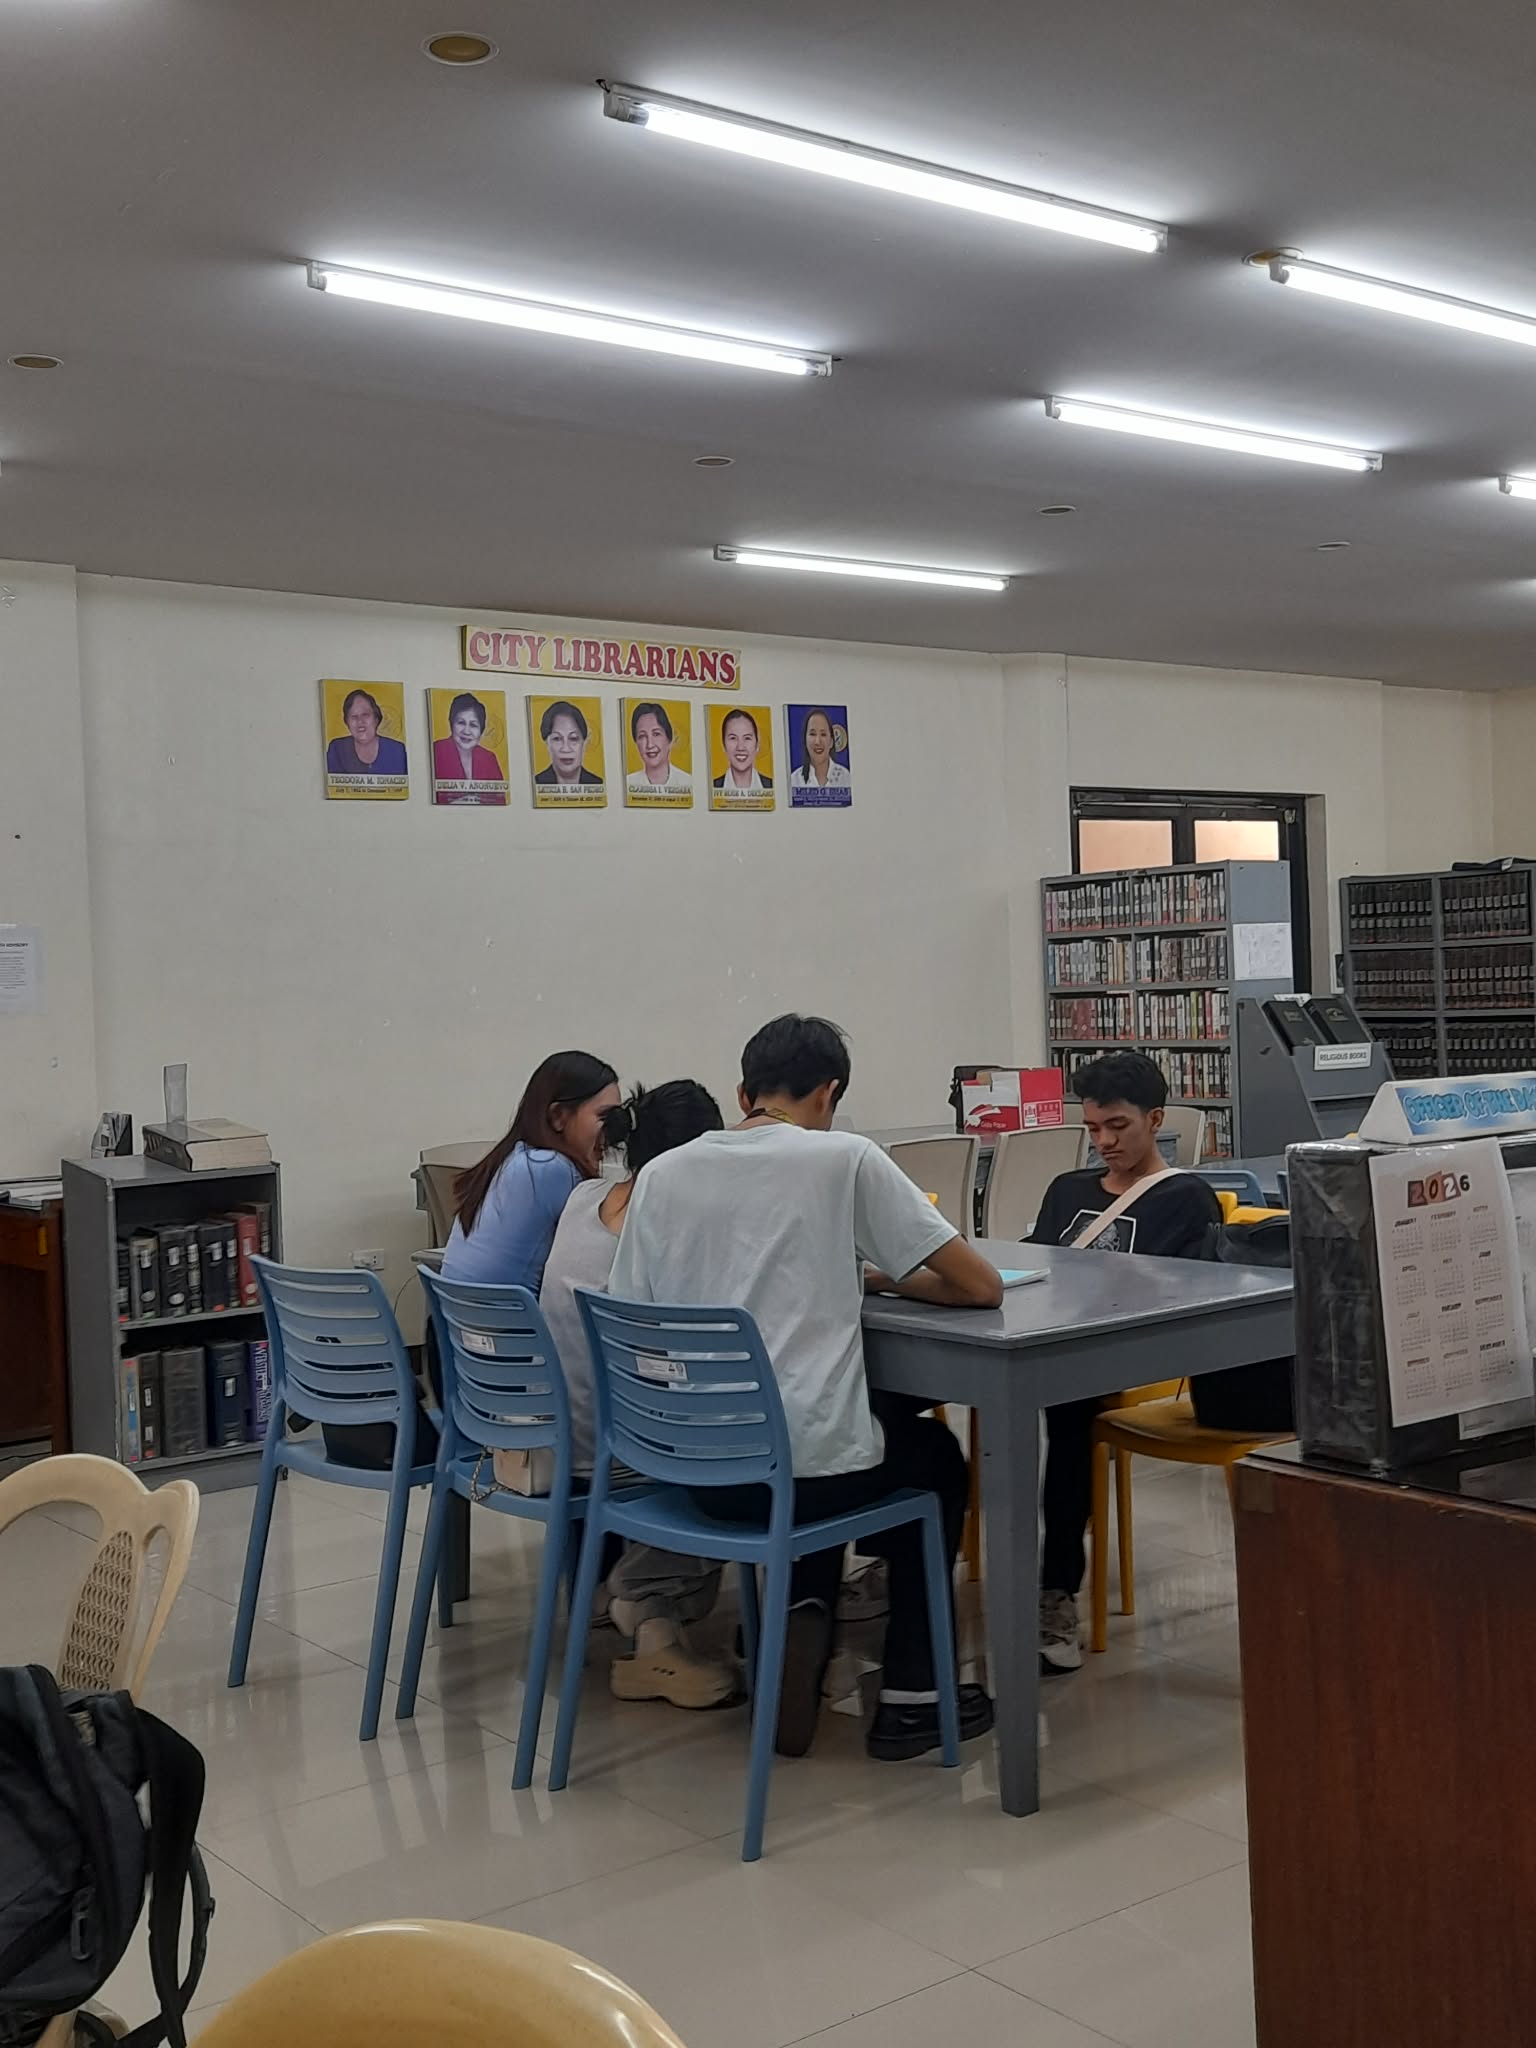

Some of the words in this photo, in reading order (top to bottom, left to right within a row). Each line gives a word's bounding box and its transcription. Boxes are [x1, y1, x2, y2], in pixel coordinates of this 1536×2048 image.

[469, 631, 546, 669] CITY
[553, 638, 736, 684] LIBRARIANS
[1319, 1052, 1348, 1061] RELIGIOUS
[1349, 1051, 1368, 1060] BOOKS
[1404, 1093, 1466, 1122] OFFICER
[1481, 1088, 1519, 1115] THE
[1408, 1173, 1470, 1207] 2026
